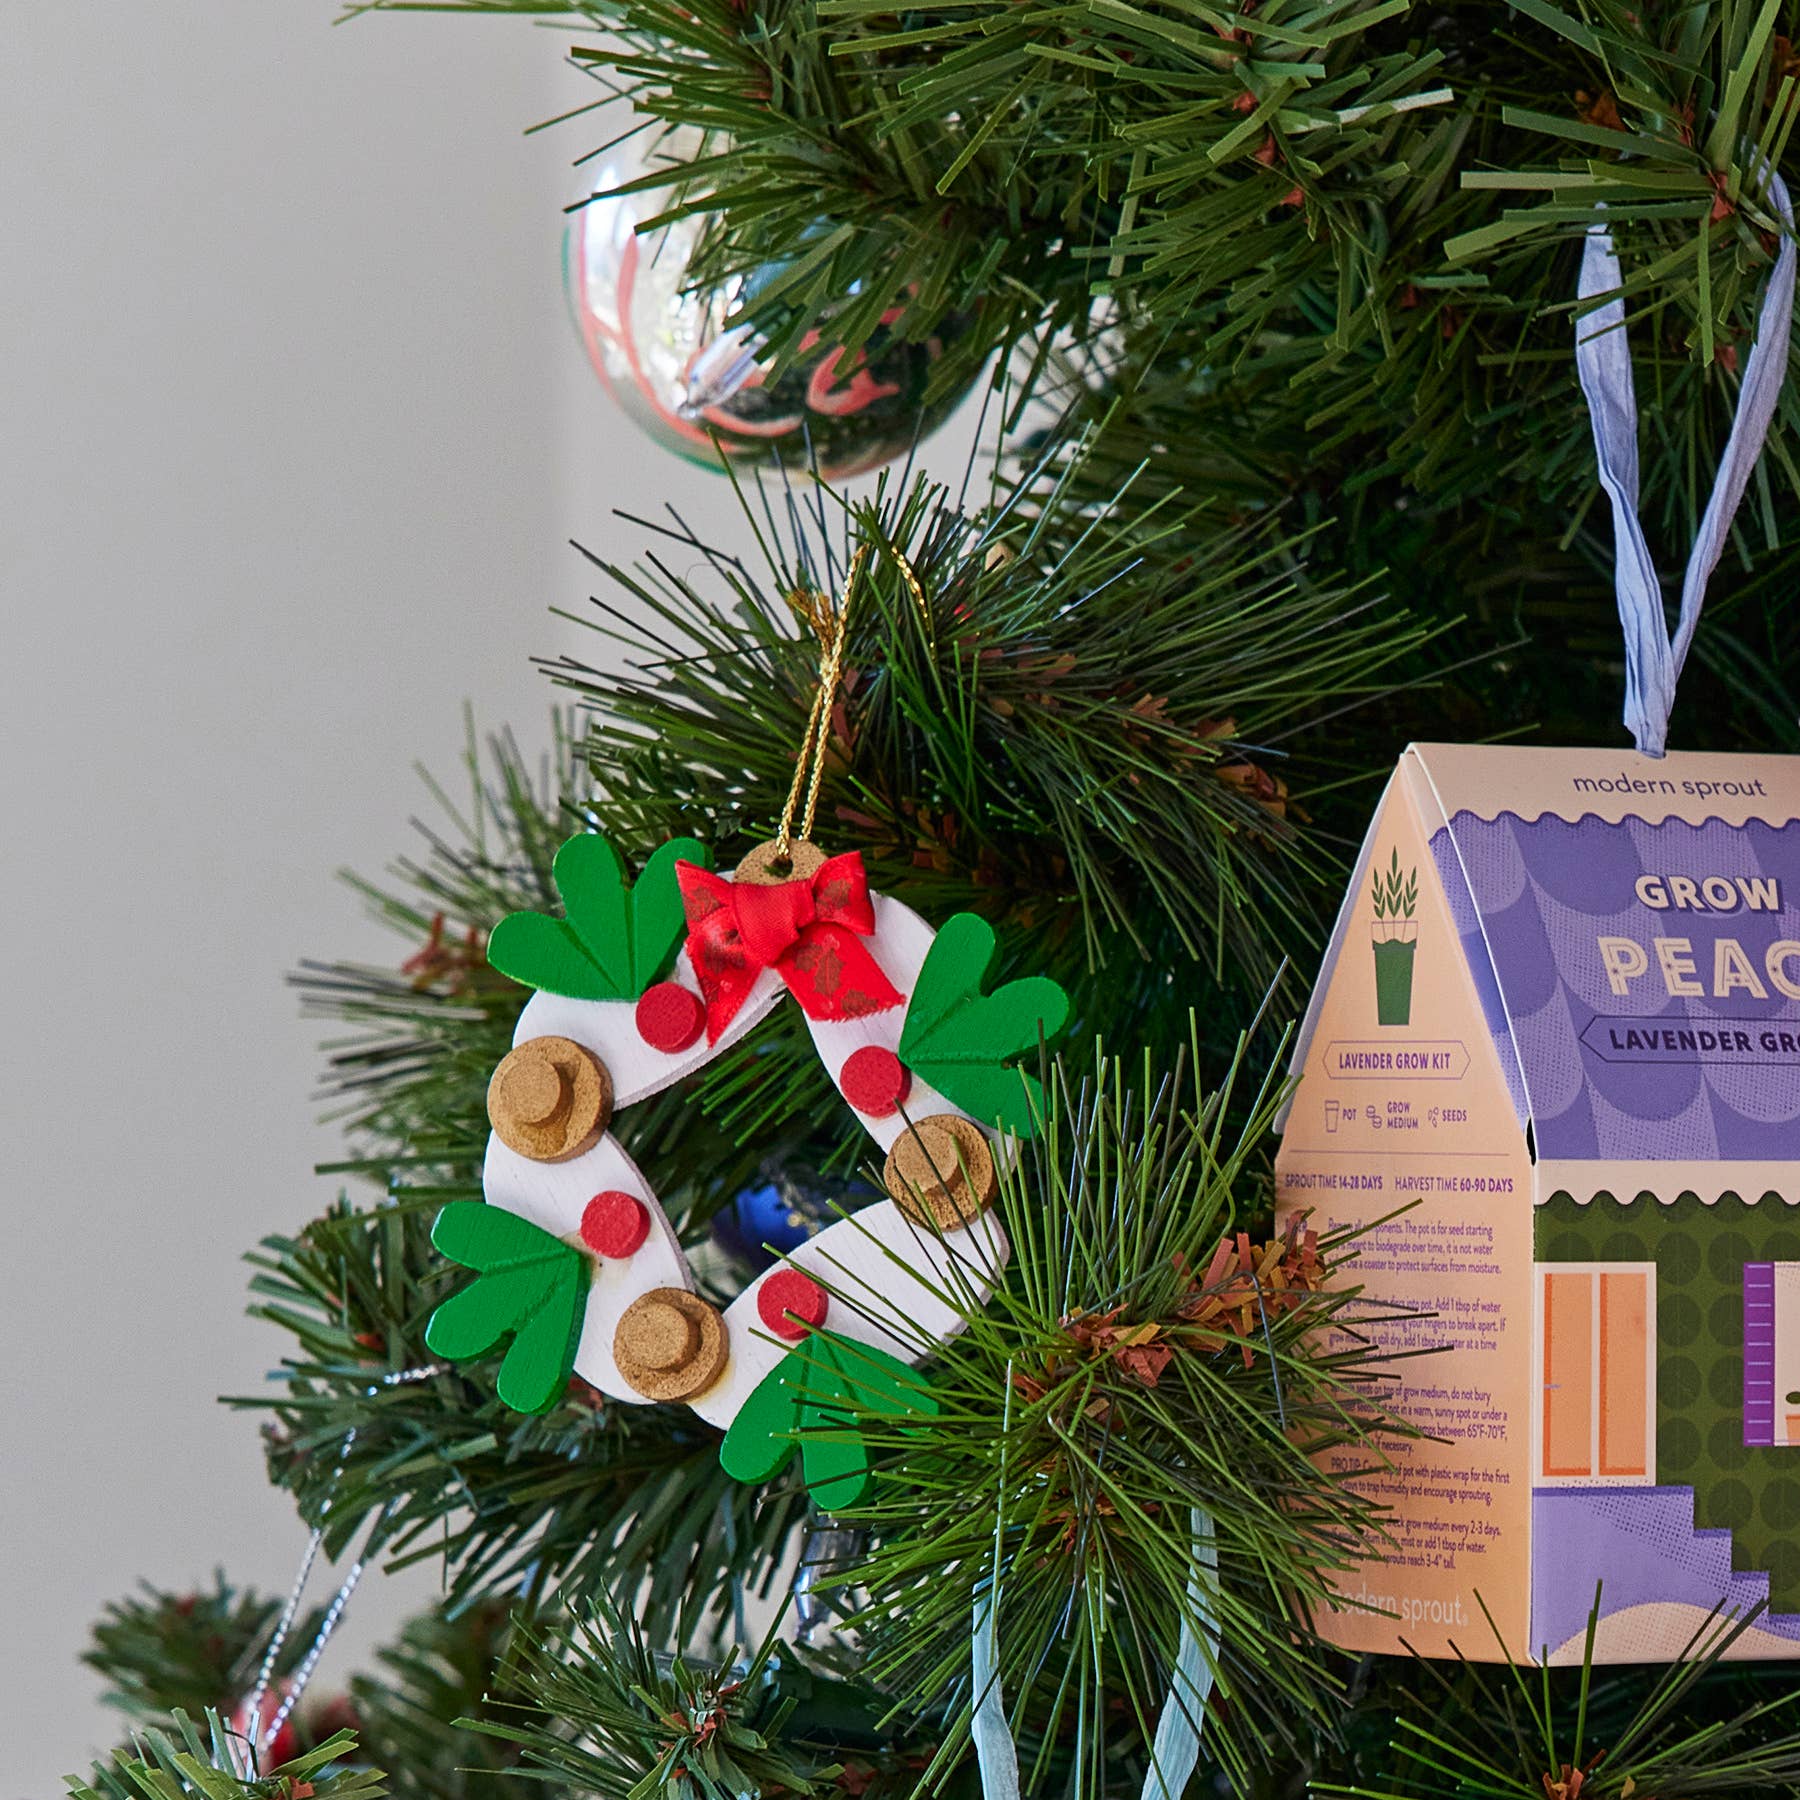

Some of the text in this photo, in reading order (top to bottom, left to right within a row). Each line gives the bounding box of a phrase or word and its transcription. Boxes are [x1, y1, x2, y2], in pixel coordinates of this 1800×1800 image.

[1573, 773, 1767, 799] modern sprout
[1634, 874, 1784, 912] GROW
[1609, 1029, 1754, 1052] LAVENDER
[1339, 1053, 1451, 1070] LAVENDER GROW KIT
[1343, 1109, 1356, 1120] POT
[1387, 1101, 1410, 1113] GROW
[1442, 1109, 1467, 1121] SEEDS
[1387, 1118, 1418, 1129] MEDIUM
[1285, 1174, 1317, 1188] SPROUT
[1319, 1174, 1337, 1189] TIME
[1362, 1175, 1382, 1190] DAYS
[1395, 1177, 1513, 1192] HARVEST TIME 60-90 DAYS
[1404, 1219, 1416, 1234] The
[1418, 1223, 1429, 1239] pot
[1438, 1220, 1447, 1234] for
[1449, 1221, 1464, 1236] seed
[1466, 1222, 1493, 1242] starting
[1412, 1243, 1426, 1253] over
[1460, 1242, 1471, 1255] not
[1473, 1243, 1493, 1256] water
[1396, 1259, 1420, 1276] protect
[1421, 1257, 1448, 1273] surfaces
[1450, 1258, 1466, 1274] from
[1436, 1297, 1449, 1311] Add
[1481, 1301, 1501, 1313] water
[1457, 1316, 1476, 1331] break
[1451, 1386, 1460, 1399] do
[1461, 1389, 1472, 1400] not
[1474, 1386, 1492, 1407] bury
[1435, 1407, 1454, 1423] sunny
[1456, 1408, 1470, 1424] spot
[1472, 1410, 1480, 1420] or
[1481, 1406, 1501, 1421] under
[1437, 1421, 1465, 1438] between
[1453, 1471, 1469, 1487] wrap
[1470, 1467, 1480, 1482] for
[1482, 1467, 1494, 1483] the
[1424, 1486, 1457, 1505] encourage
[1423, 1517, 1449, 1532] medium
[1451, 1522, 1469, 1542] every
[1471, 1520, 1482, 1535] 2-3
